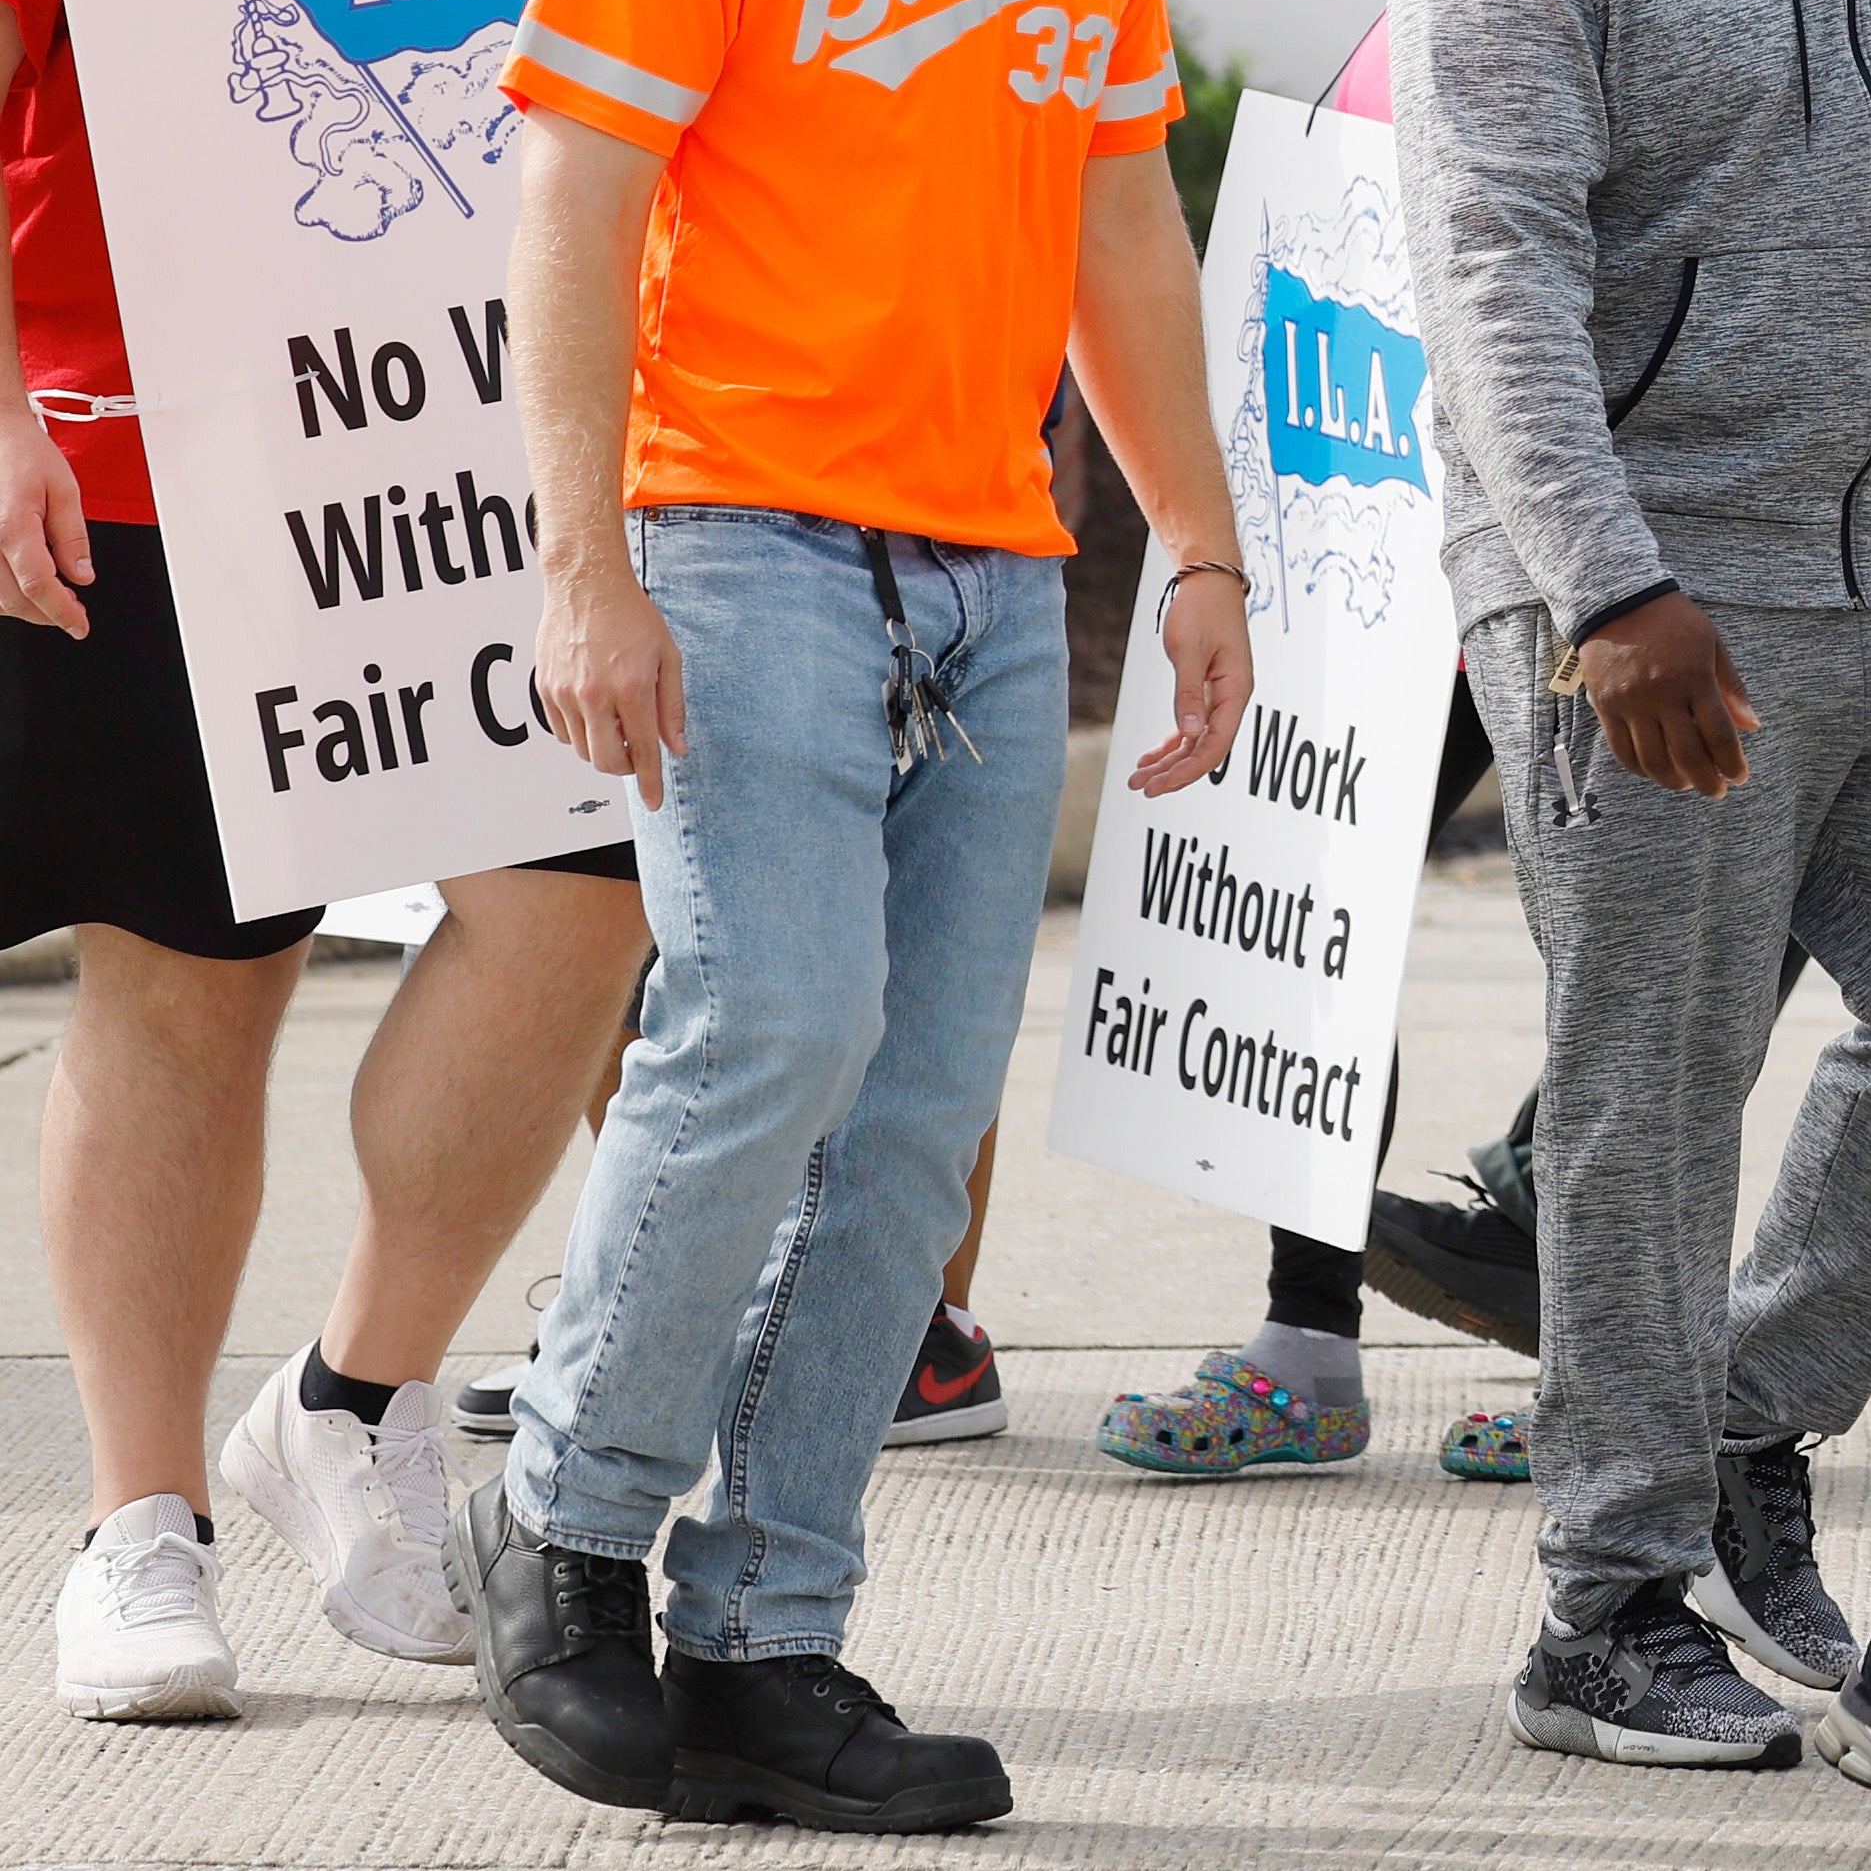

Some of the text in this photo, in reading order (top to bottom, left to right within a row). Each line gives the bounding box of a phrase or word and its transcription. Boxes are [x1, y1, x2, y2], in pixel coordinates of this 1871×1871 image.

[1008, 5, 1117, 109] 33
[287, 327, 427, 439] No
[1282, 319, 1411, 459] I.L.A.
[285, 471, 539, 611] With
[255, 663, 435, 794] Fair
[1247, 703, 1370, 827] Work
[1140, 826, 1351, 982] Without a
[1085, 967, 1362, 1143] Fair Contract
